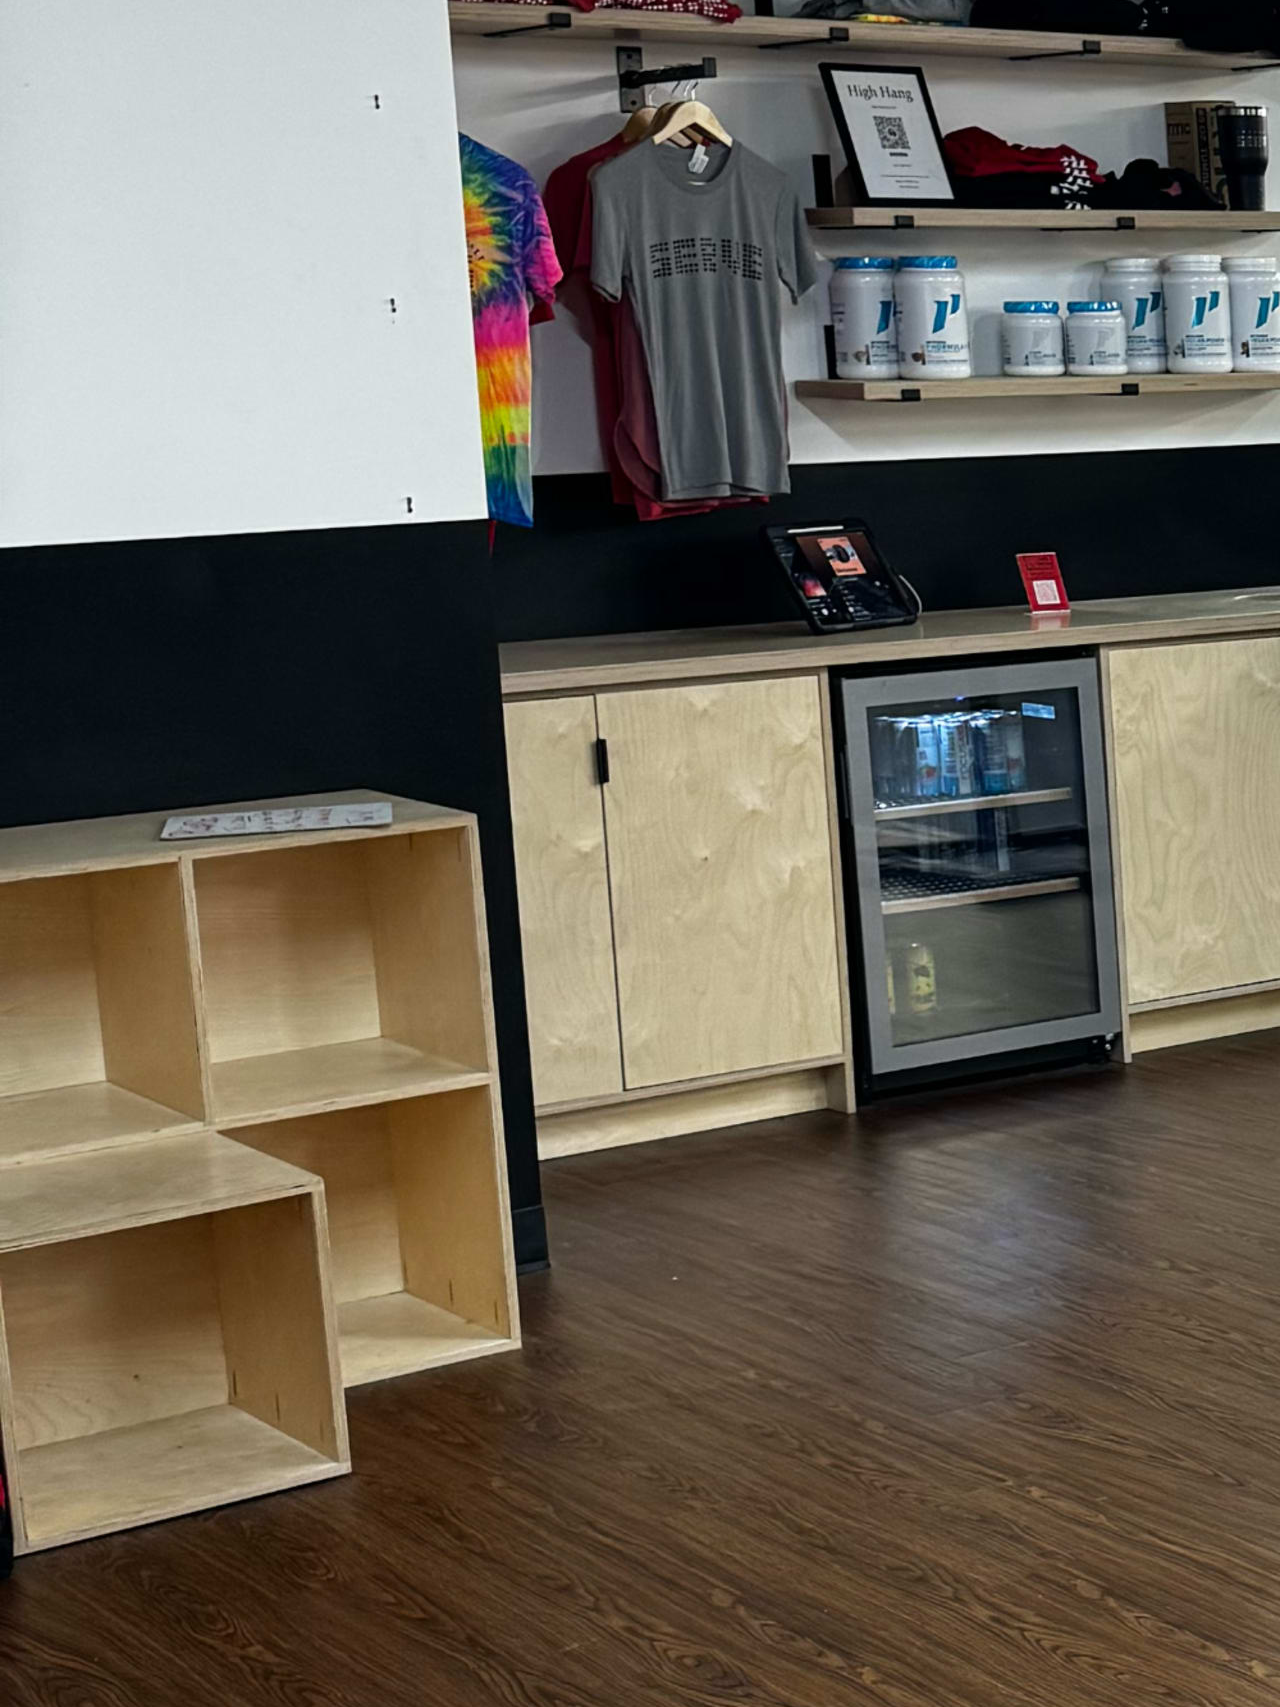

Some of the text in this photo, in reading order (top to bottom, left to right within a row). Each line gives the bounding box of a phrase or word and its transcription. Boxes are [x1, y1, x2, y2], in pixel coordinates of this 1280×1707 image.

[847, 84, 914, 103] High Hang
[649, 237, 763, 281] SERVE
